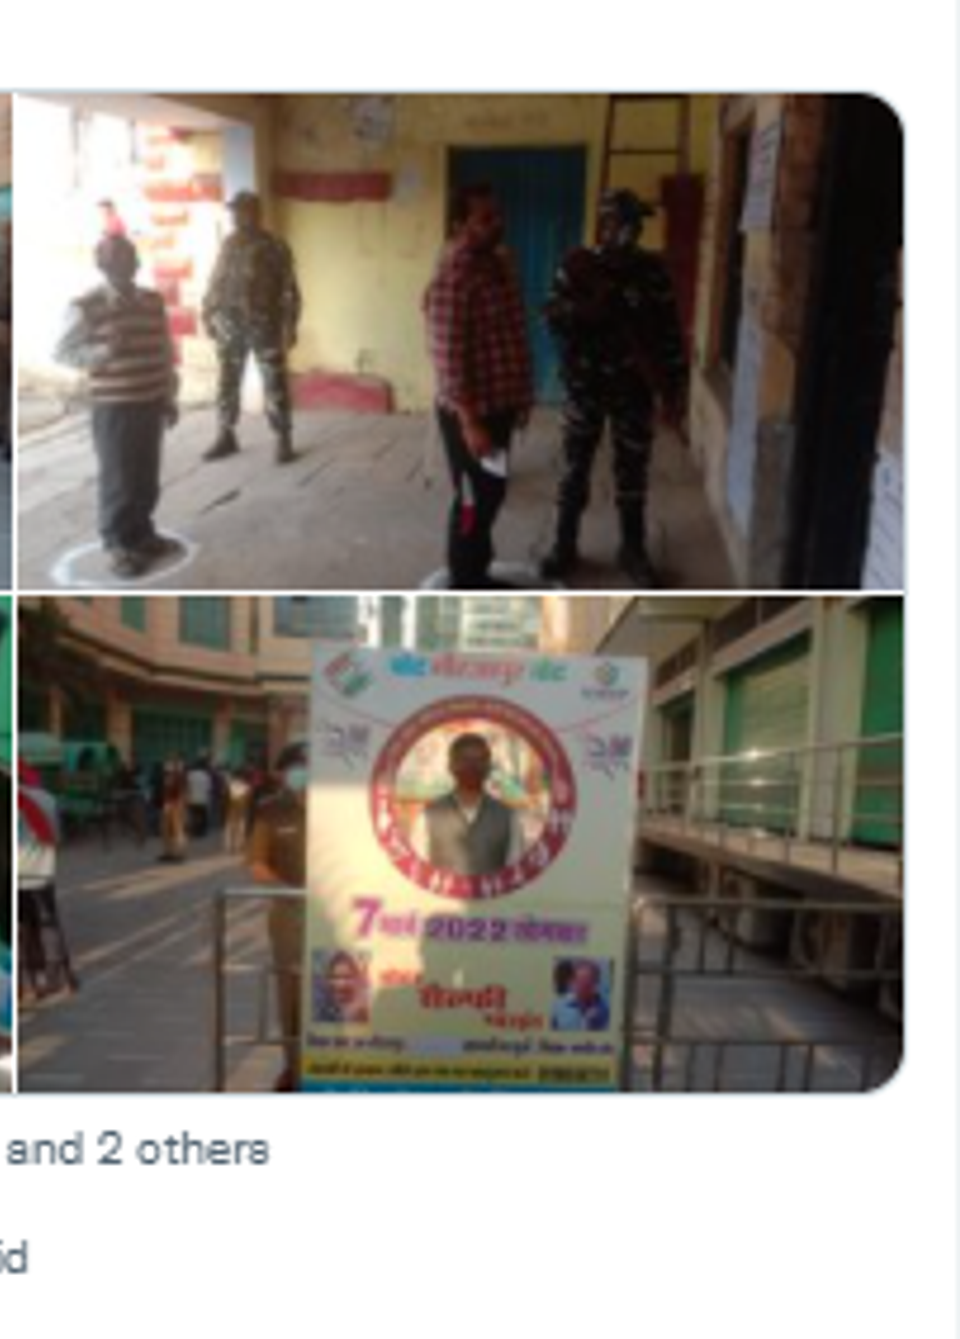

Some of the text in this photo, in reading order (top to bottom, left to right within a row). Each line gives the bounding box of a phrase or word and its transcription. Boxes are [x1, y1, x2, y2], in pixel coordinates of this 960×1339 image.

[426, 917, 507, 941] 2022
[7, 1132, 82, 1165] and
[98, 1130, 122, 1165] 2
[137, 1131, 268, 1165] others
